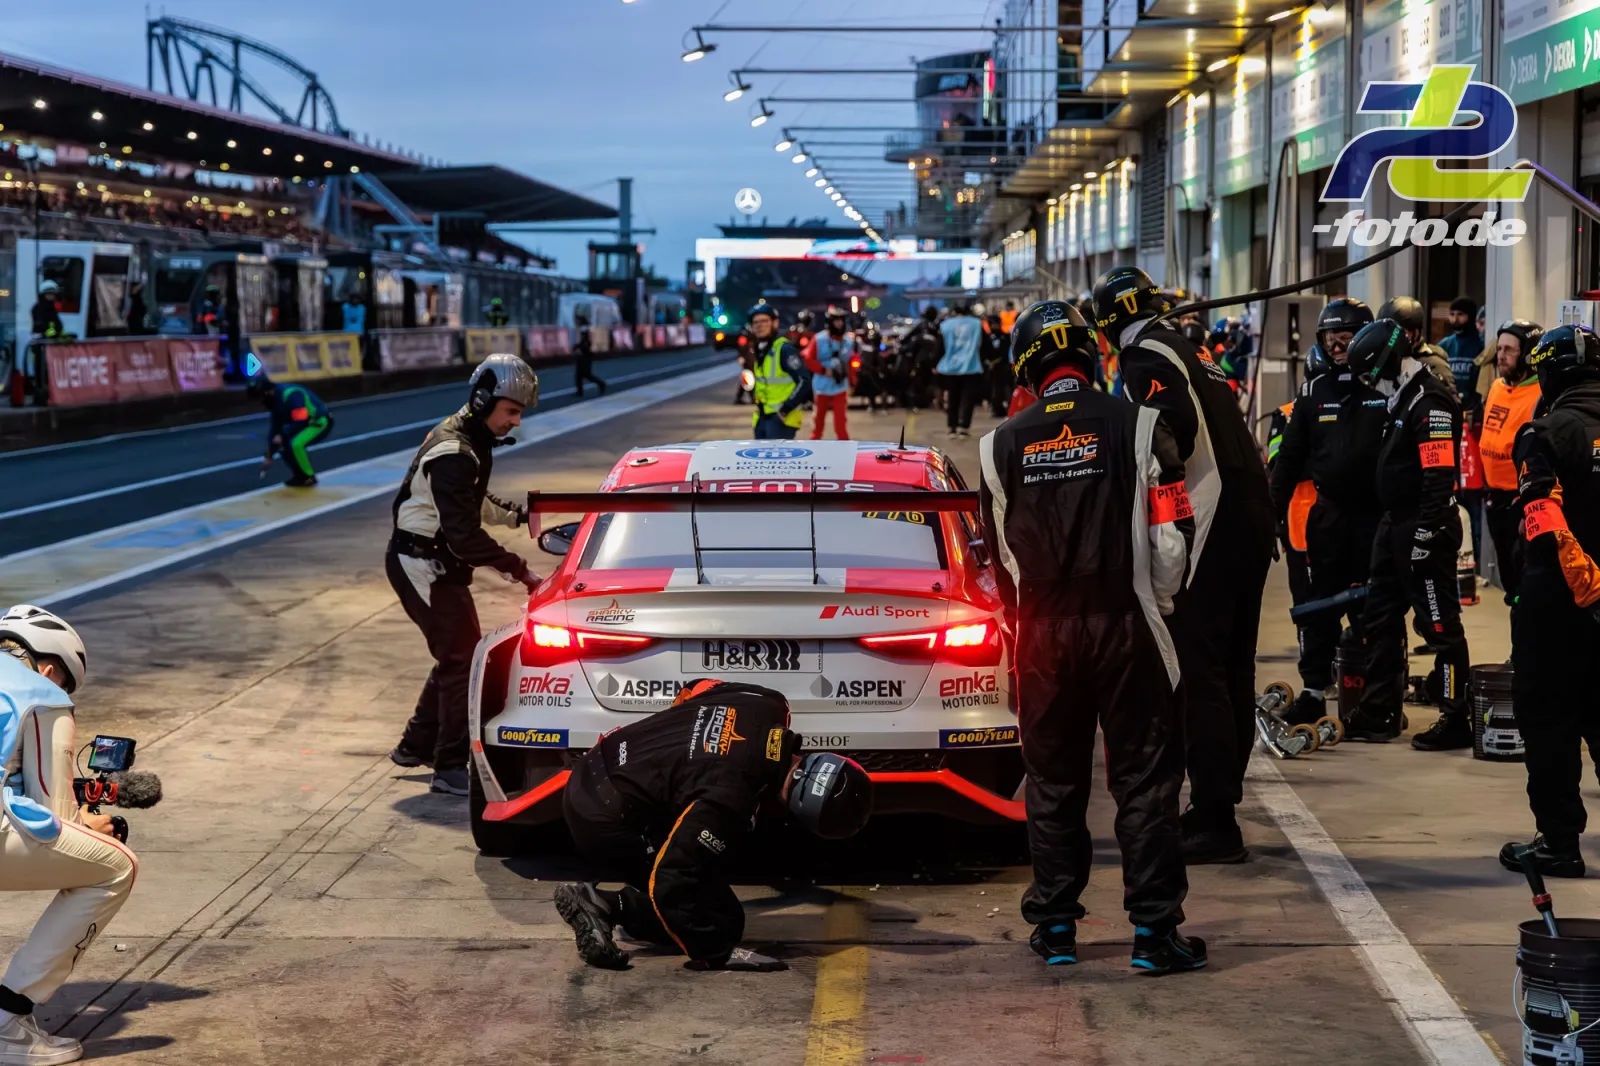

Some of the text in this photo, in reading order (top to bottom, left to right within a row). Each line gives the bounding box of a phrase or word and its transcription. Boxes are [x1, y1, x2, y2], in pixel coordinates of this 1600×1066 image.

[1553, 38, 1576, 73] DEKRA
[1517, 52, 1538, 84] DEKRA
[53, 355, 109, 389] WEMPE
[1022, 444, 1098, 465] RACING
[1157, 484, 1186, 500] PITLA
[1425, 579, 1441, 621] PARKSIDE
[586, 614, 636, 622] RACING
[841, 605, 930, 619] Audi Sport
[702, 640, 768, 671] H&R
[836, 680, 903, 698] ASPEN
[519, 695, 572, 708] MOTOR OILS
[941, 693, 1000, 710] MOTOR OILS
[501, 729, 561, 744] GOODYEAR
[708, 705, 728, 754] RACING
[948, 728, 1015, 745] GOODYEAR
[801, 735, 851, 748] GSHOF
